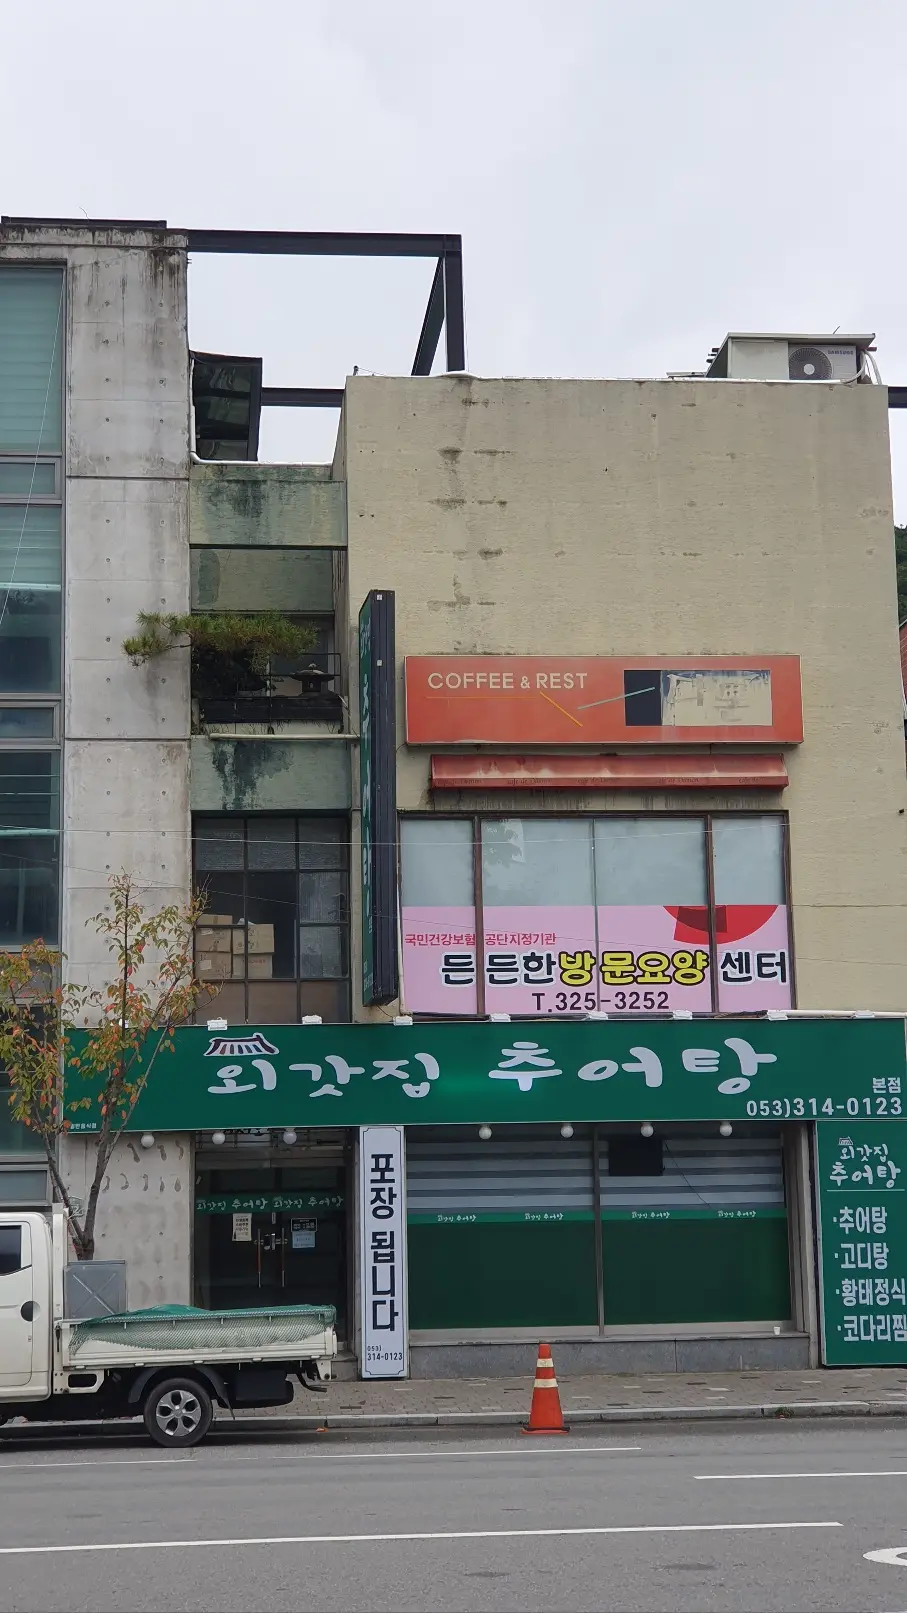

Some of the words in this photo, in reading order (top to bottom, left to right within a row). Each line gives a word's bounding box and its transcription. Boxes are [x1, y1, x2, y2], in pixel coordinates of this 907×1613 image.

[428, 673, 514, 689] COFFEE
[520, 675, 530, 689] &
[536, 673, 587, 689] REST
[532, 991, 670, 1013] T.325-3252
[207, 1053, 440, 1098] 외갓집
[488, 1037, 778, 1095] 추어탕
[872, 1077, 902, 1094] 본점
[746, 1097, 903, 1118] 053)314-0123
[840, 1143, 889, 1162] 외갓집
[370, 1153, 397, 1220] 포장
[829, 1160, 902, 1188] 추어탕
[839, 1206, 888, 1234] 추어탕
[840, 1242, 890, 1270] 고디탕
[370, 1231, 399, 1332] 됩니다
[841, 1278, 906, 1307] 황태정식
[843, 1314, 907, 1342] 코다리찜
[367, 1352, 403, 1361] 314-0123
